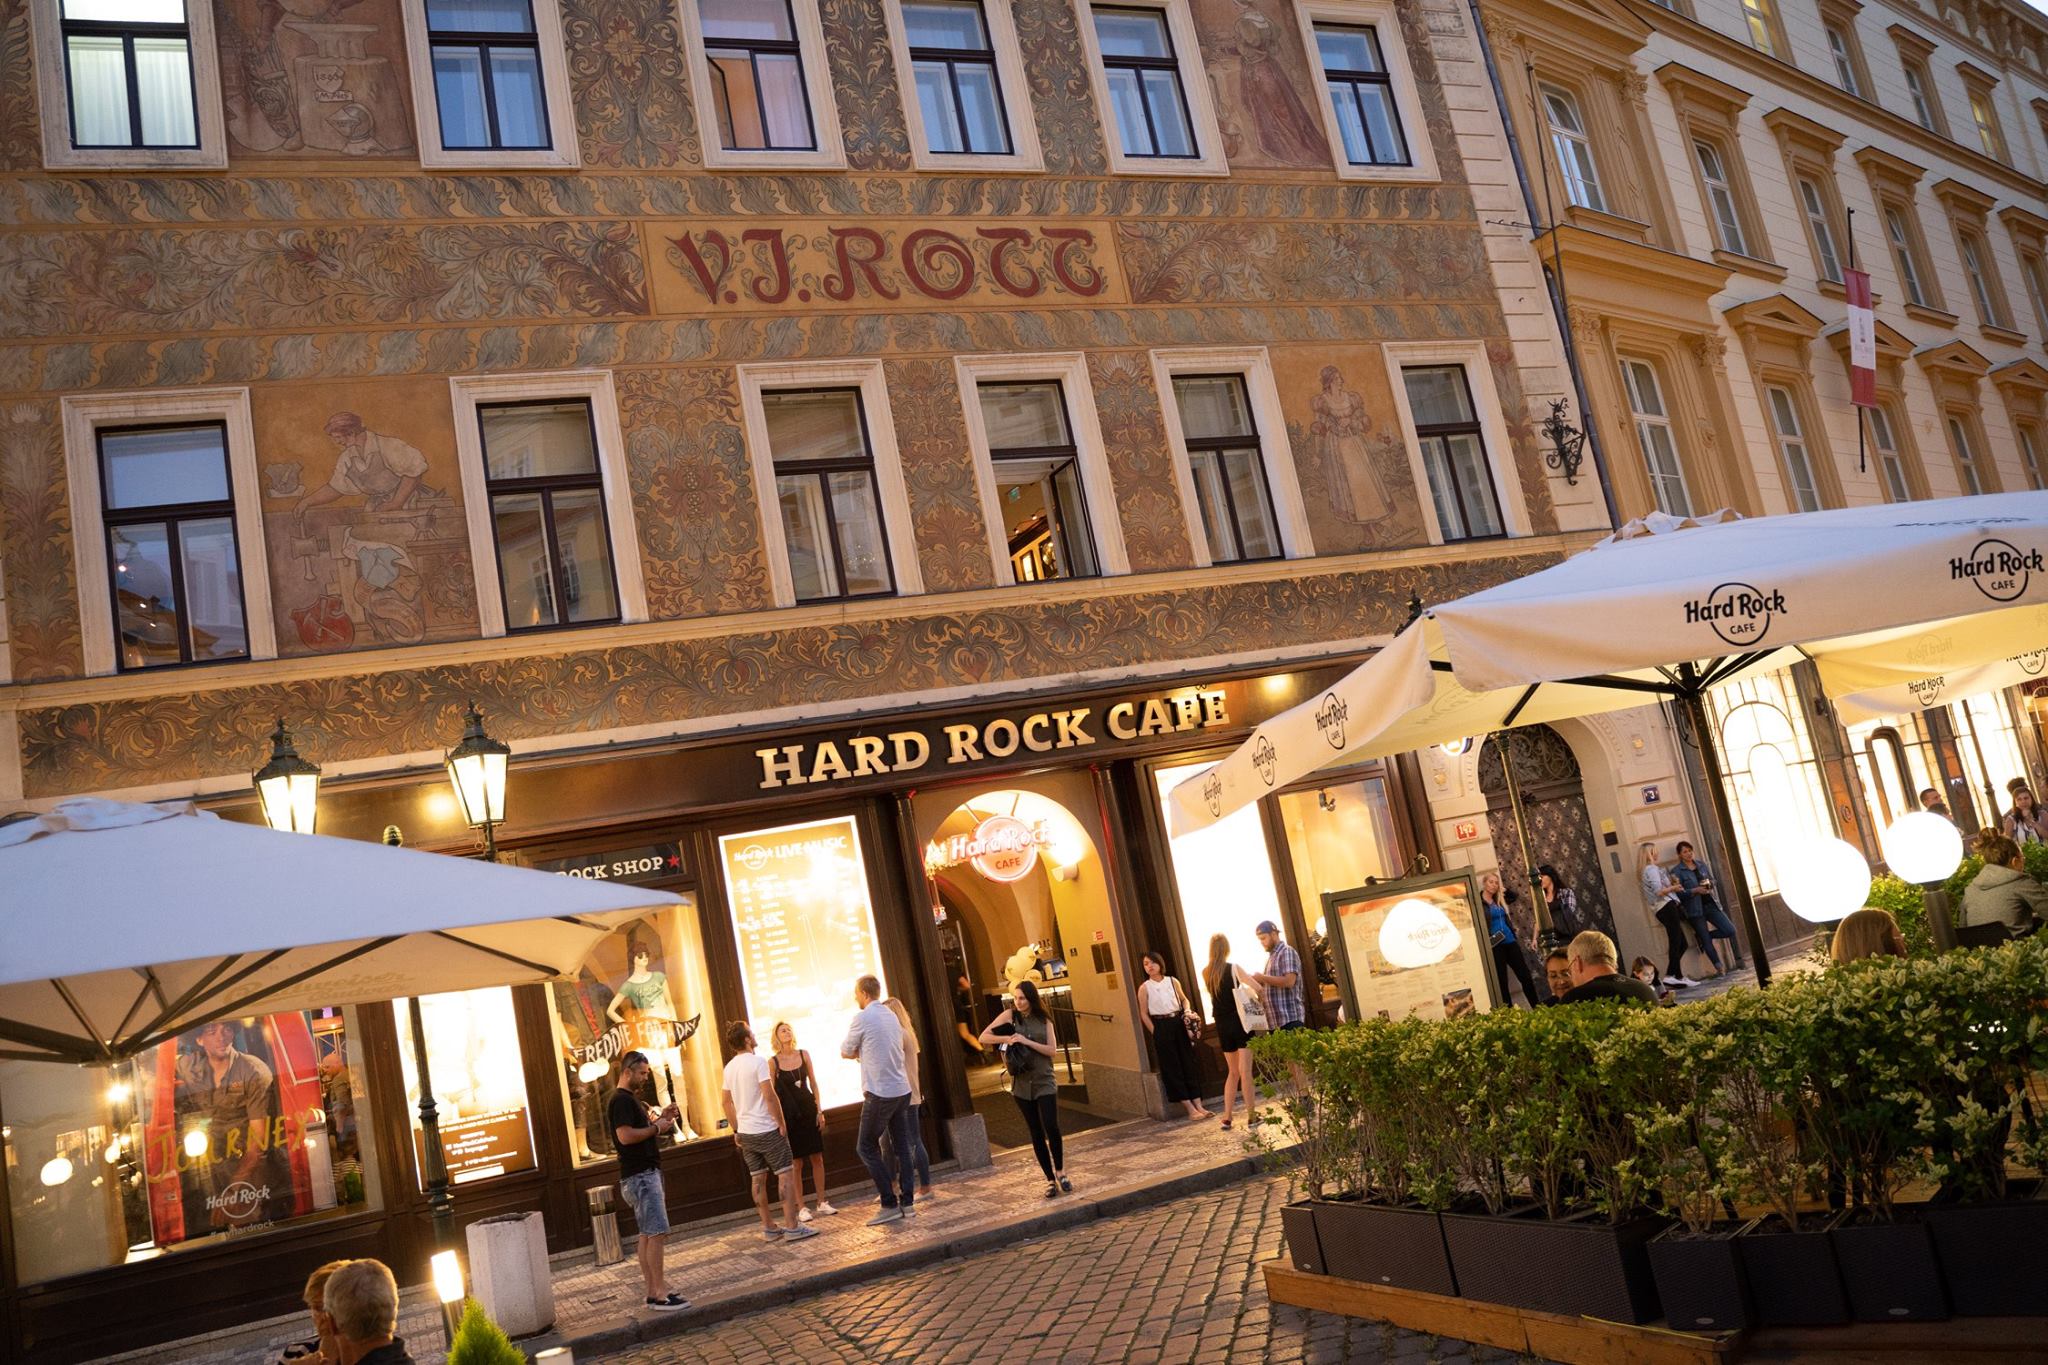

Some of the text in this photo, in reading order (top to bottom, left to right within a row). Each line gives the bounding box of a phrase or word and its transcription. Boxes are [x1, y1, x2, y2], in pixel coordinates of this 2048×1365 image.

[1949, 548, 2045, 580] Hard Rock
[1991, 579, 2016, 591] CAFE
[1683, 589, 1788, 624] Hard Rock
[1729, 622, 1756, 635] CAFE
[1314, 698, 1349, 731] Hard Rock
[754, 688, 1231, 790] HARD ROCK CAFE
[950, 828, 1002, 861] Hard
[612, 856, 664, 877] SHOP
[994, 856, 1022, 870] CAFE
[573, 1023, 633, 1063] FREDDIE
[674, 1018, 698, 1041] DAY
[205, 1184, 271, 1210] Hard Rock
